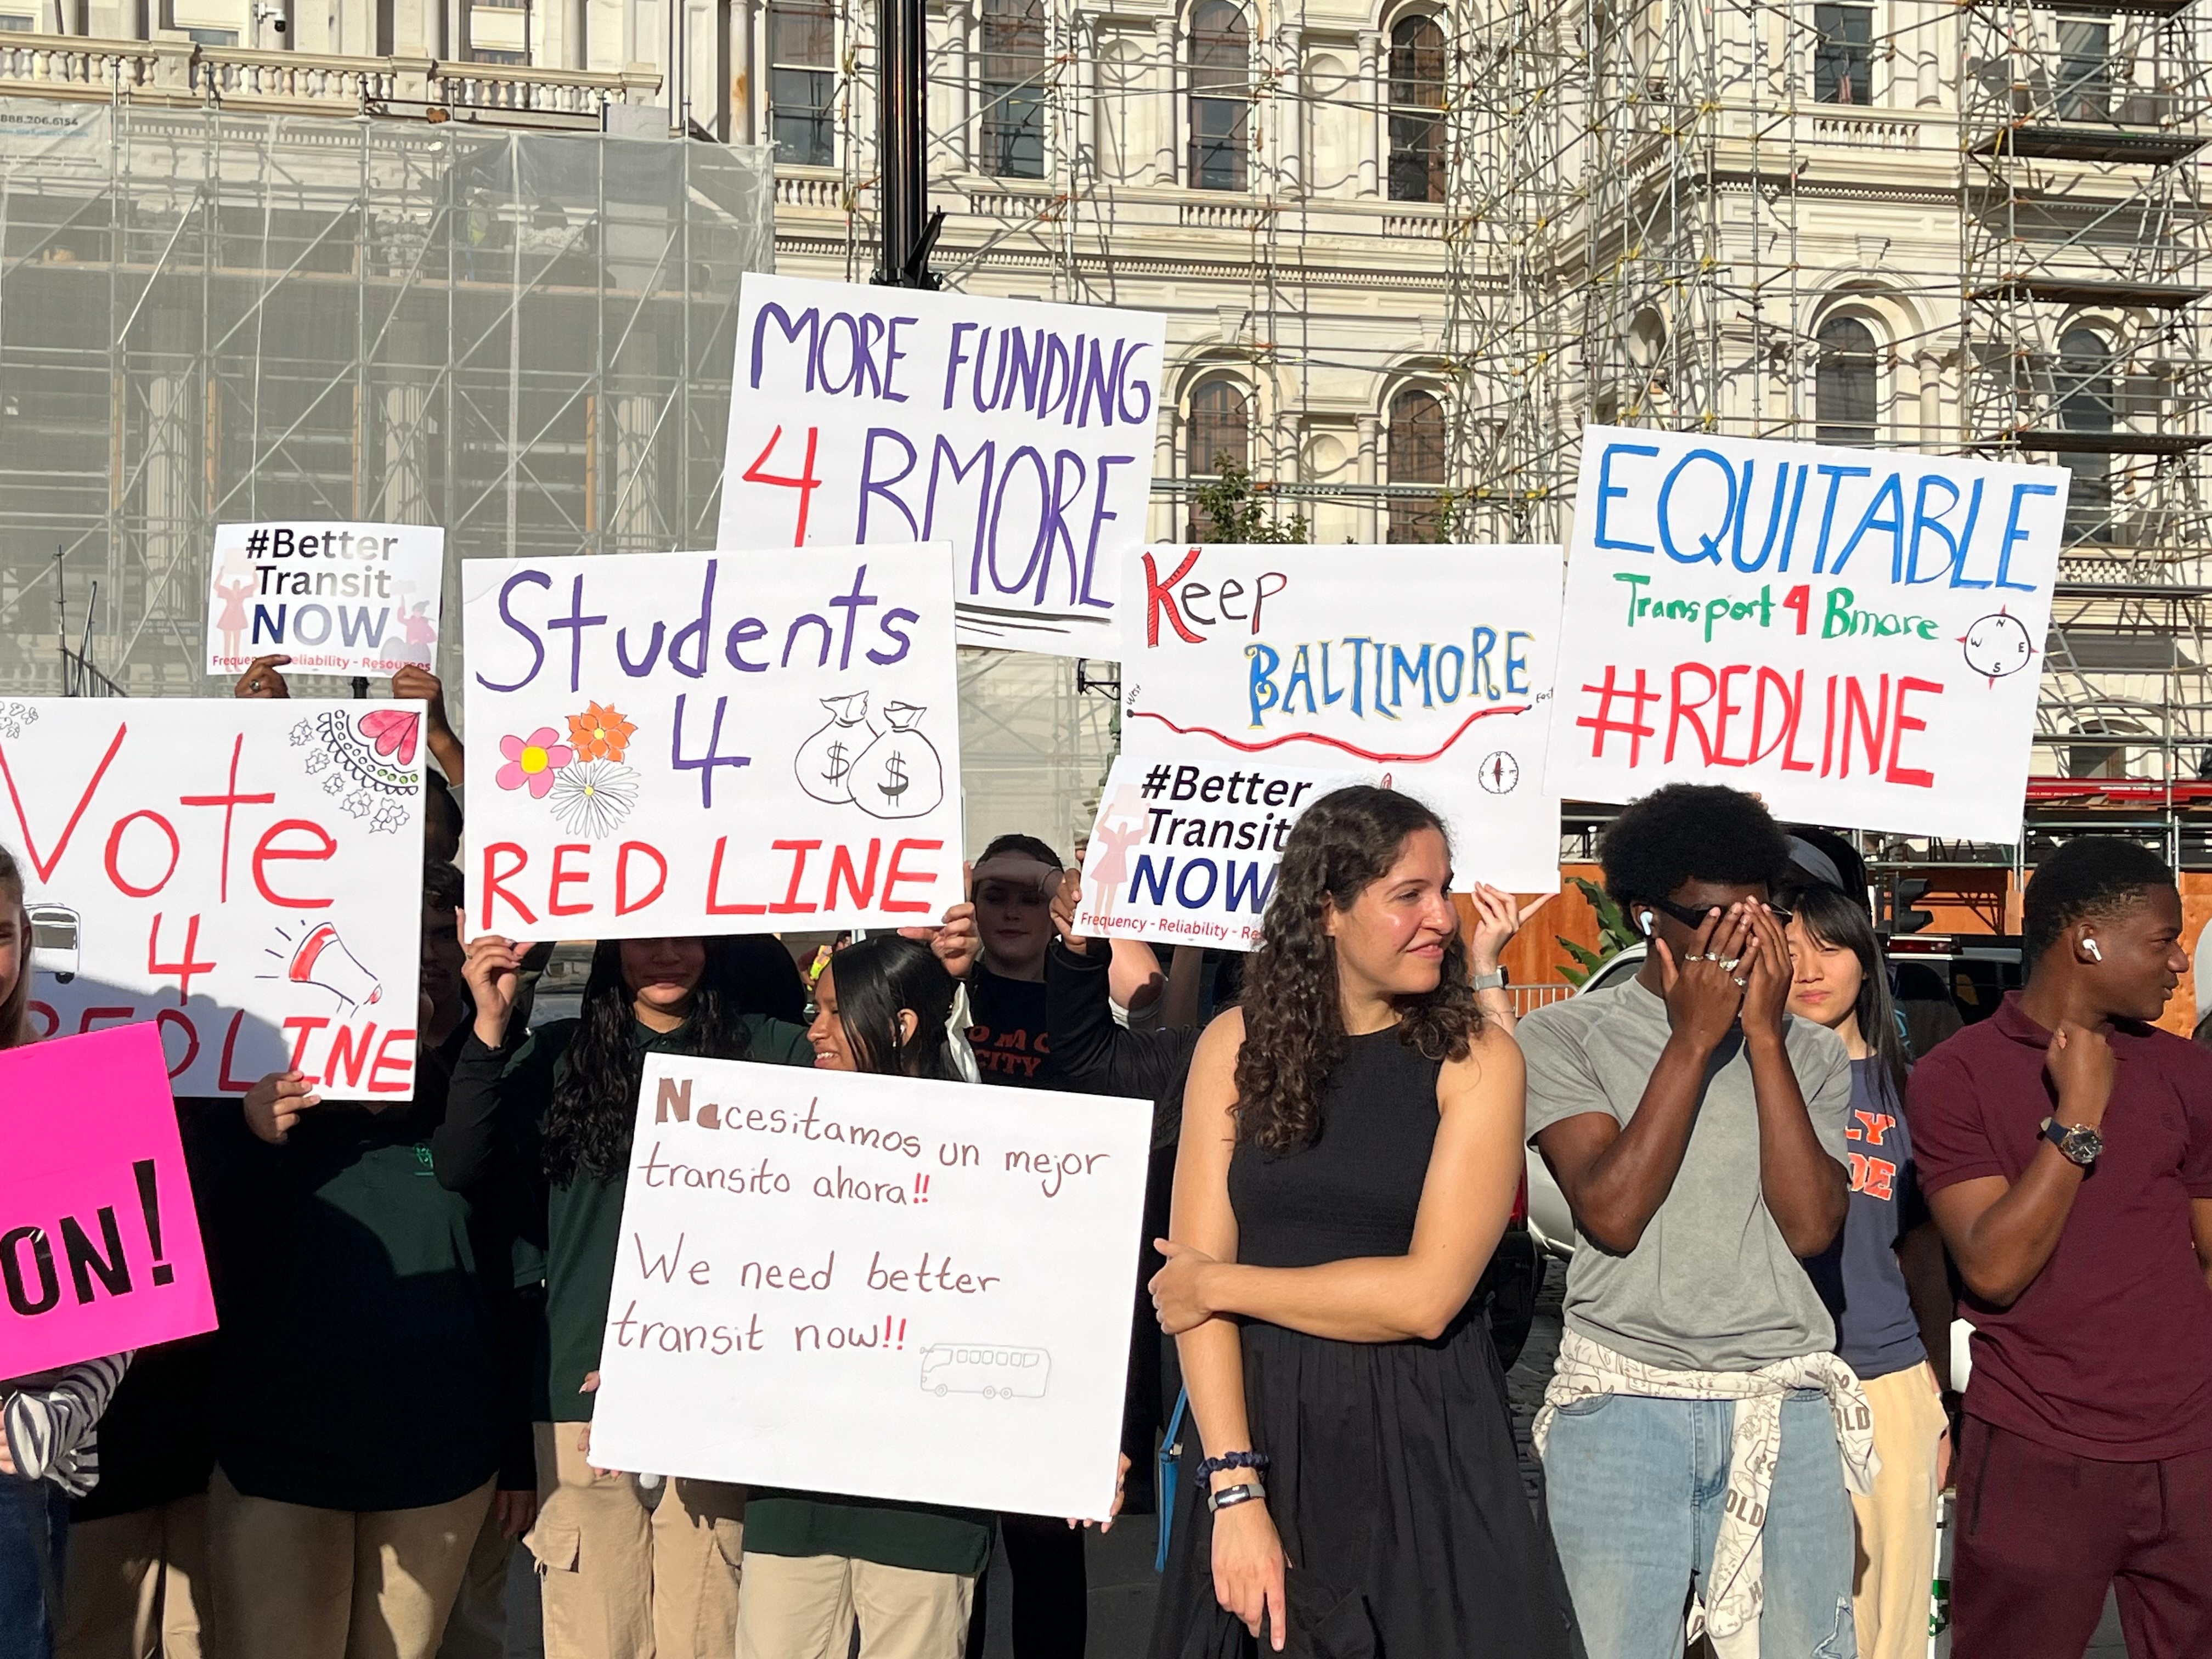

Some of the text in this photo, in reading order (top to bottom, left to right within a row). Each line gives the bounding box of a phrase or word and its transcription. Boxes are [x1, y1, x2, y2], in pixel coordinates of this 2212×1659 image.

[751, 302, 1154, 428] MORE FUNDING
[742, 425, 822, 548] 4
[1594, 443, 2058, 591] EQUITABLE
[246, 528, 398, 561] #Better
[256, 565, 391, 599] Transit
[1141, 546, 1288, 648] Keep
[1613, 573, 1775, 642] Transport
[251, 603, 390, 648] NOW
[476, 559, 919, 692] Students
[212, 655, 256, 668] Freque
[291, 655, 350, 670] eliability
[1244, 624, 1536, 730] BALTIMORE
[673, 693, 751, 808] 4
[1576, 661, 1944, 789] #REDLINE
[0, 721, 338, 908] Vote
[1141, 764, 1313, 808] #Better
[1148, 808, 1291, 852] Transit
[482, 836, 944, 930] RED LINE
[1128, 854, 1280, 915] NOW
[1081, 912, 1148, 933] Frequency
[1159, 918, 1228, 940] Reliability
[147, 912, 218, 1007] 4
[636, 1141, 929, 1204] transito ahora!!
[939, 1140, 981, 1169] un
[1005, 1147, 1112, 1199] mejor
[633, 1231, 1002, 1295] We need better
[611, 1299, 906, 1357] transit now!!
